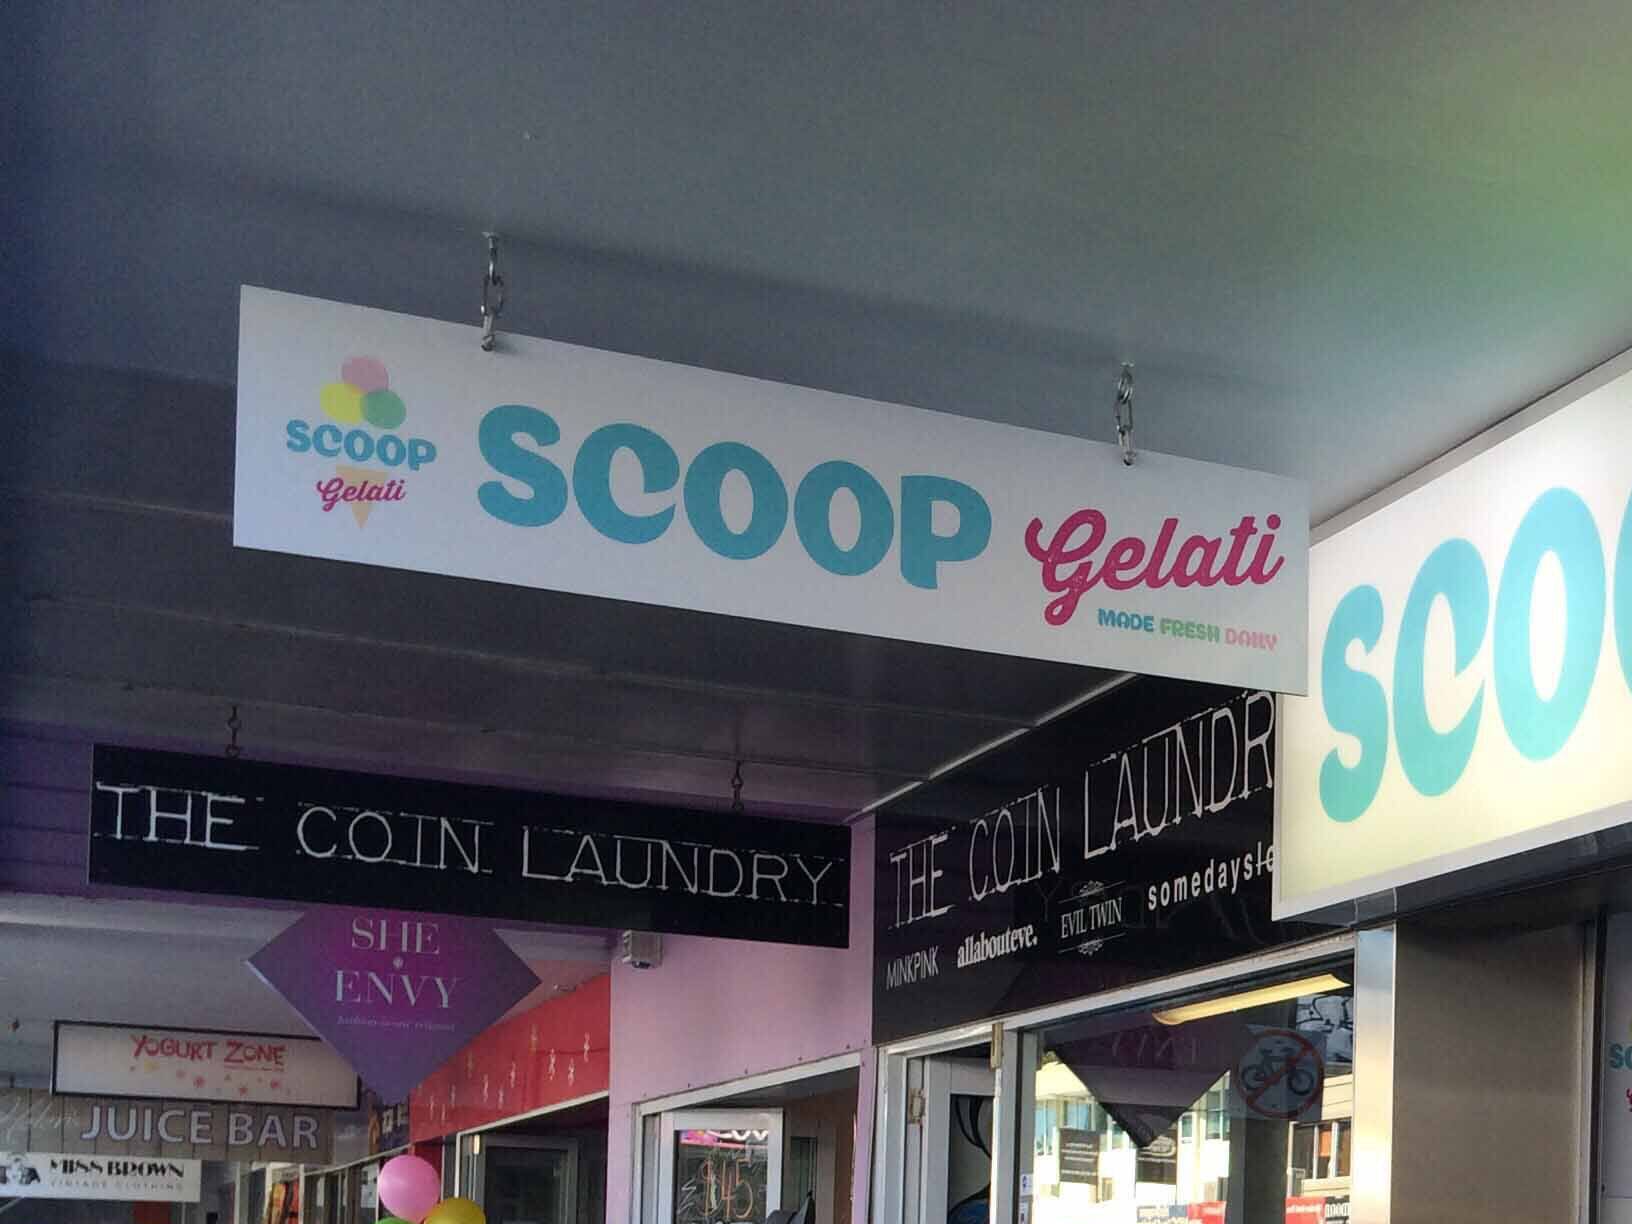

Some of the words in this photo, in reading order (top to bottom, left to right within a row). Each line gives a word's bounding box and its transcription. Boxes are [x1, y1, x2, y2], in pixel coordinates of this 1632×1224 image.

[285, 419, 437, 472] SCOOP
[316, 476, 406, 514] Gelati
[476, 404, 991, 589] SCOOP
[1024, 507, 1287, 626] Gelati
[1096, 608, 1154, 633] MADE
[1158, 617, 1221, 645] FRESH
[1224, 626, 1278, 652] DAILY
[95, 781, 258, 852] THE
[296, 803, 491, 874] COIN
[521, 826, 845, 907] LAUNDRY
[889, 828, 956, 927] THE
[968, 785, 1060, 901] COIN
[351, 915, 440, 955] SHE
[886, 946, 939, 990] MINKPINK
[1060, 911, 1086, 939] EVIL
[1089, 897, 1123, 932] TWIN
[335, 970, 457, 1008] ENVY
[129, 1035, 217, 1060] YOGURT
[223, 1040, 286, 1064] ZONE
[80, 1102, 212, 1145] JUICE
[227, 1112, 319, 1150] BAR
[107, 1160, 184, 1177] BROWN
